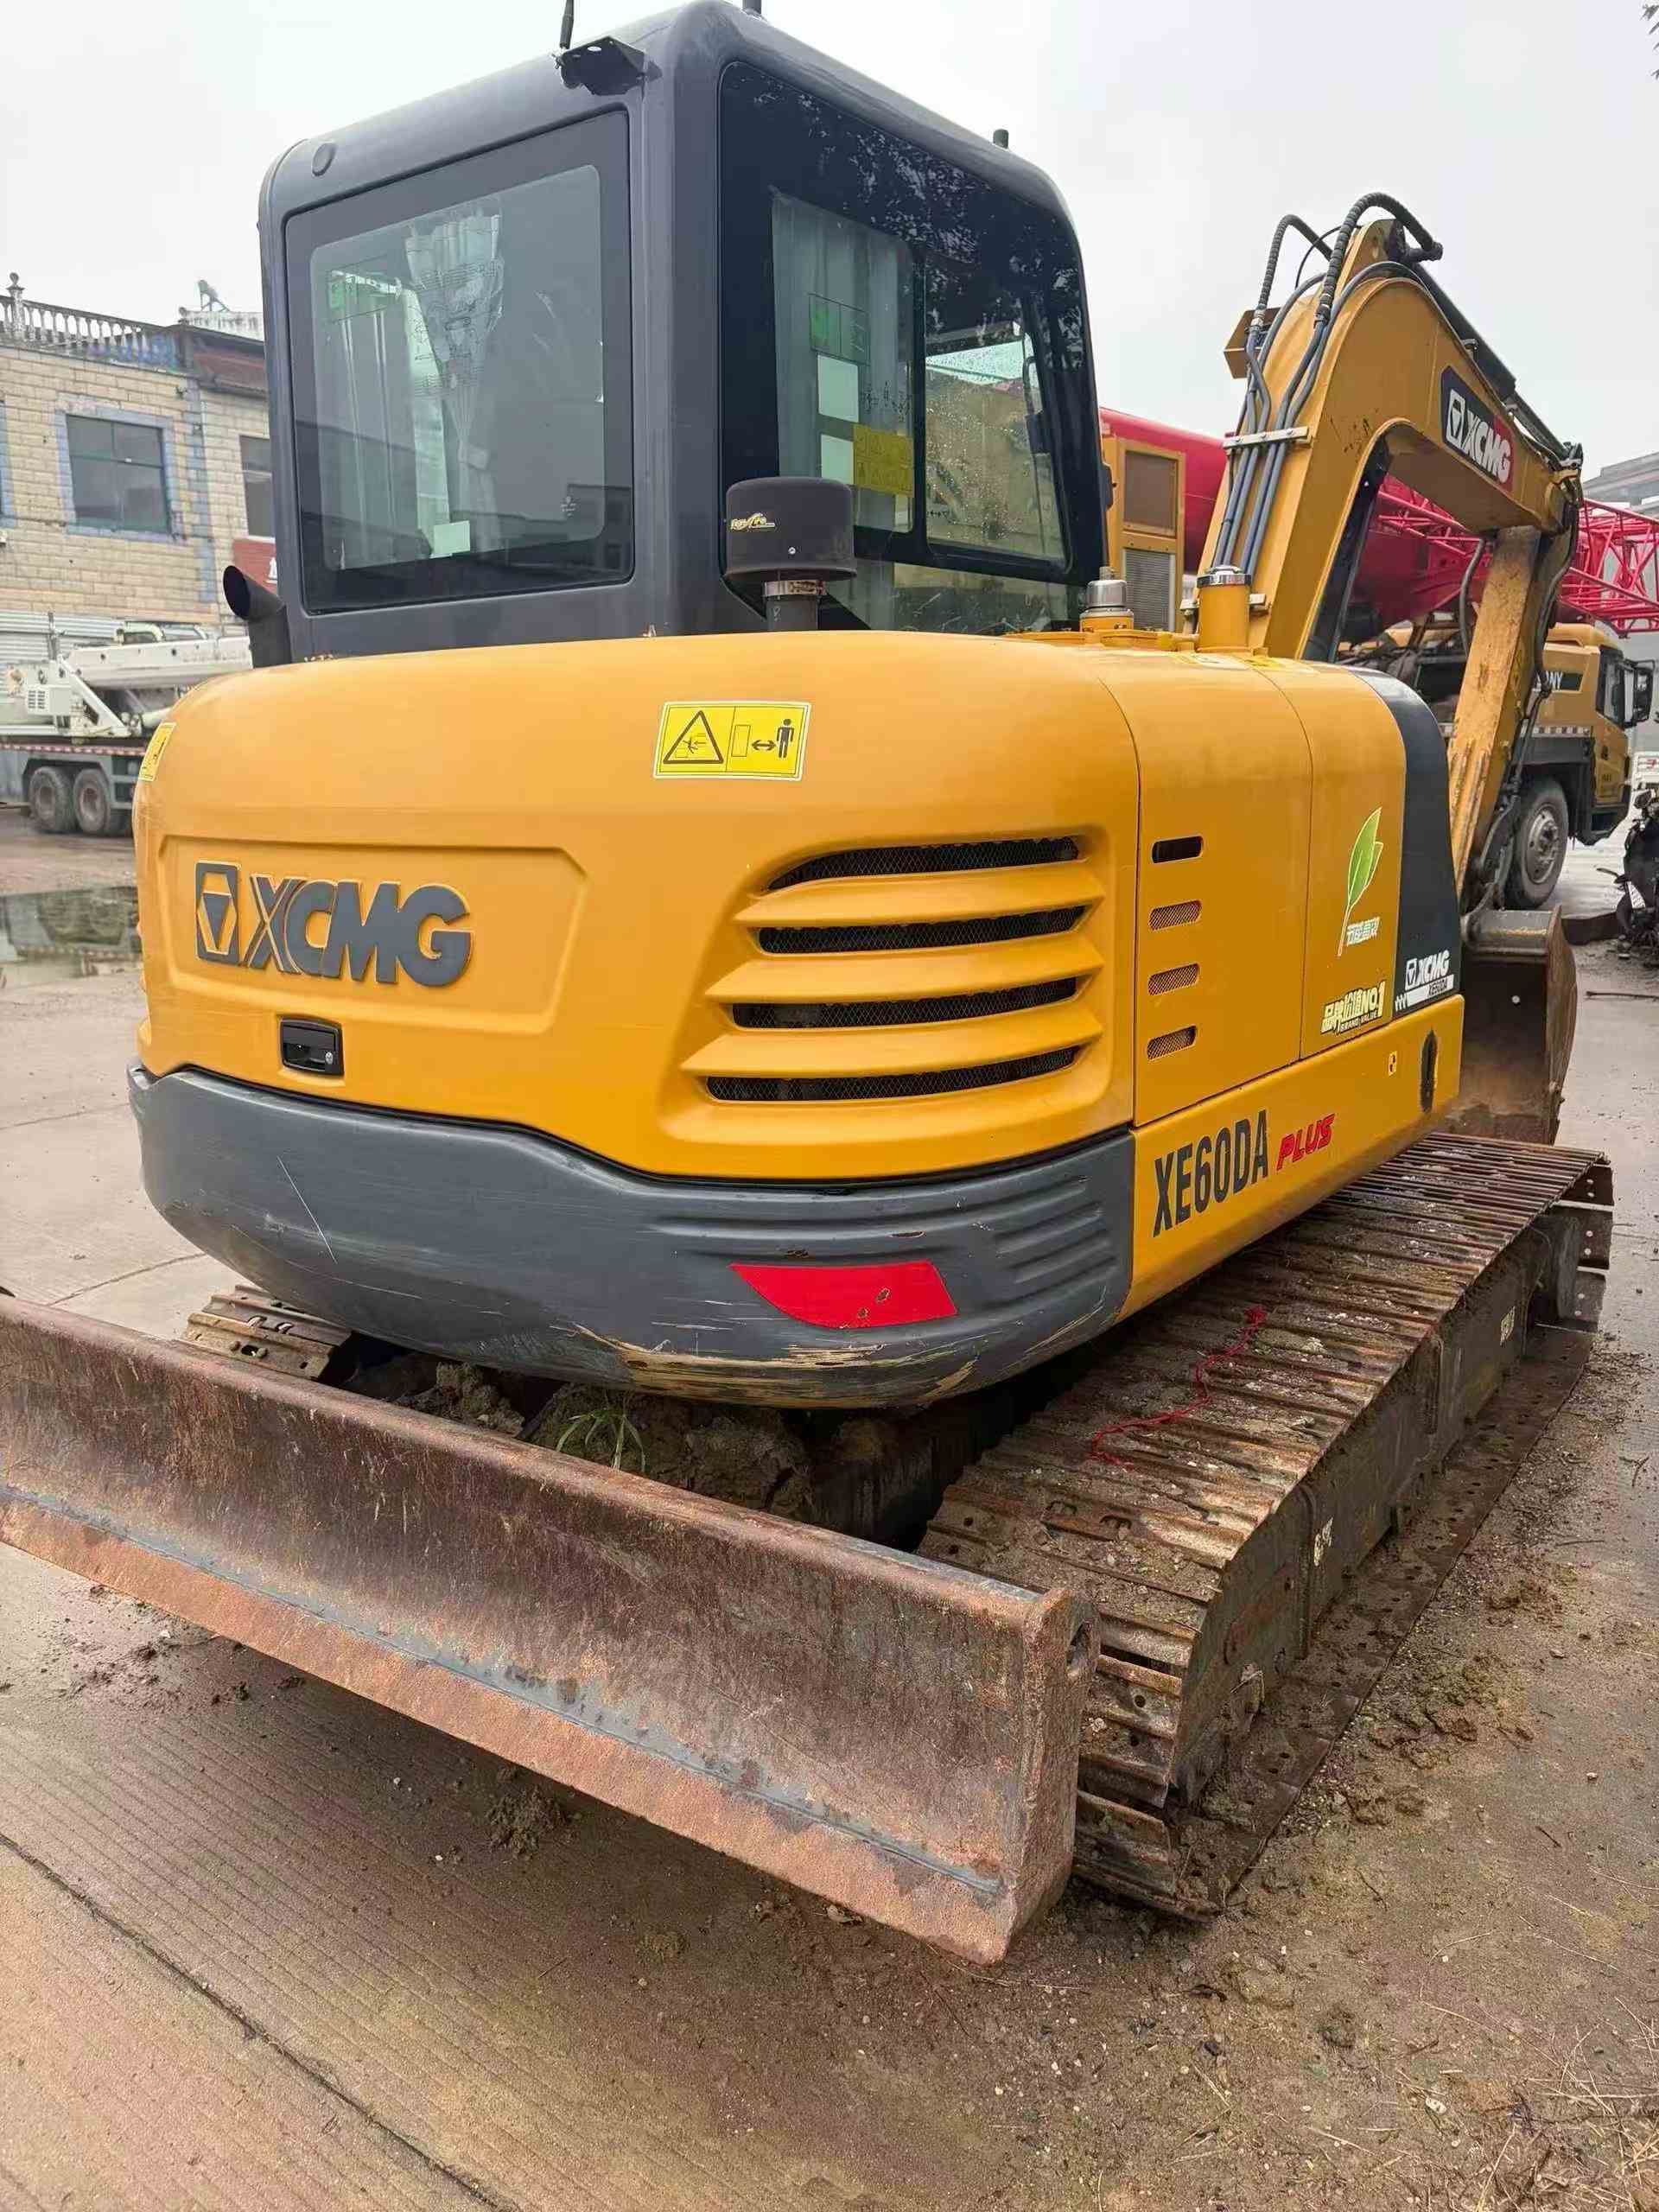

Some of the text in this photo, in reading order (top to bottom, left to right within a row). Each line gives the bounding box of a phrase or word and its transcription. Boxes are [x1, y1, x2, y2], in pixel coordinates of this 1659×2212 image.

[1461, 409, 1511, 483] XCMG
[242, 873, 474, 988] XCMG
[1418, 950, 1451, 987] XCMG
[1154, 1109, 1336, 1237] XE60DA PLUS
